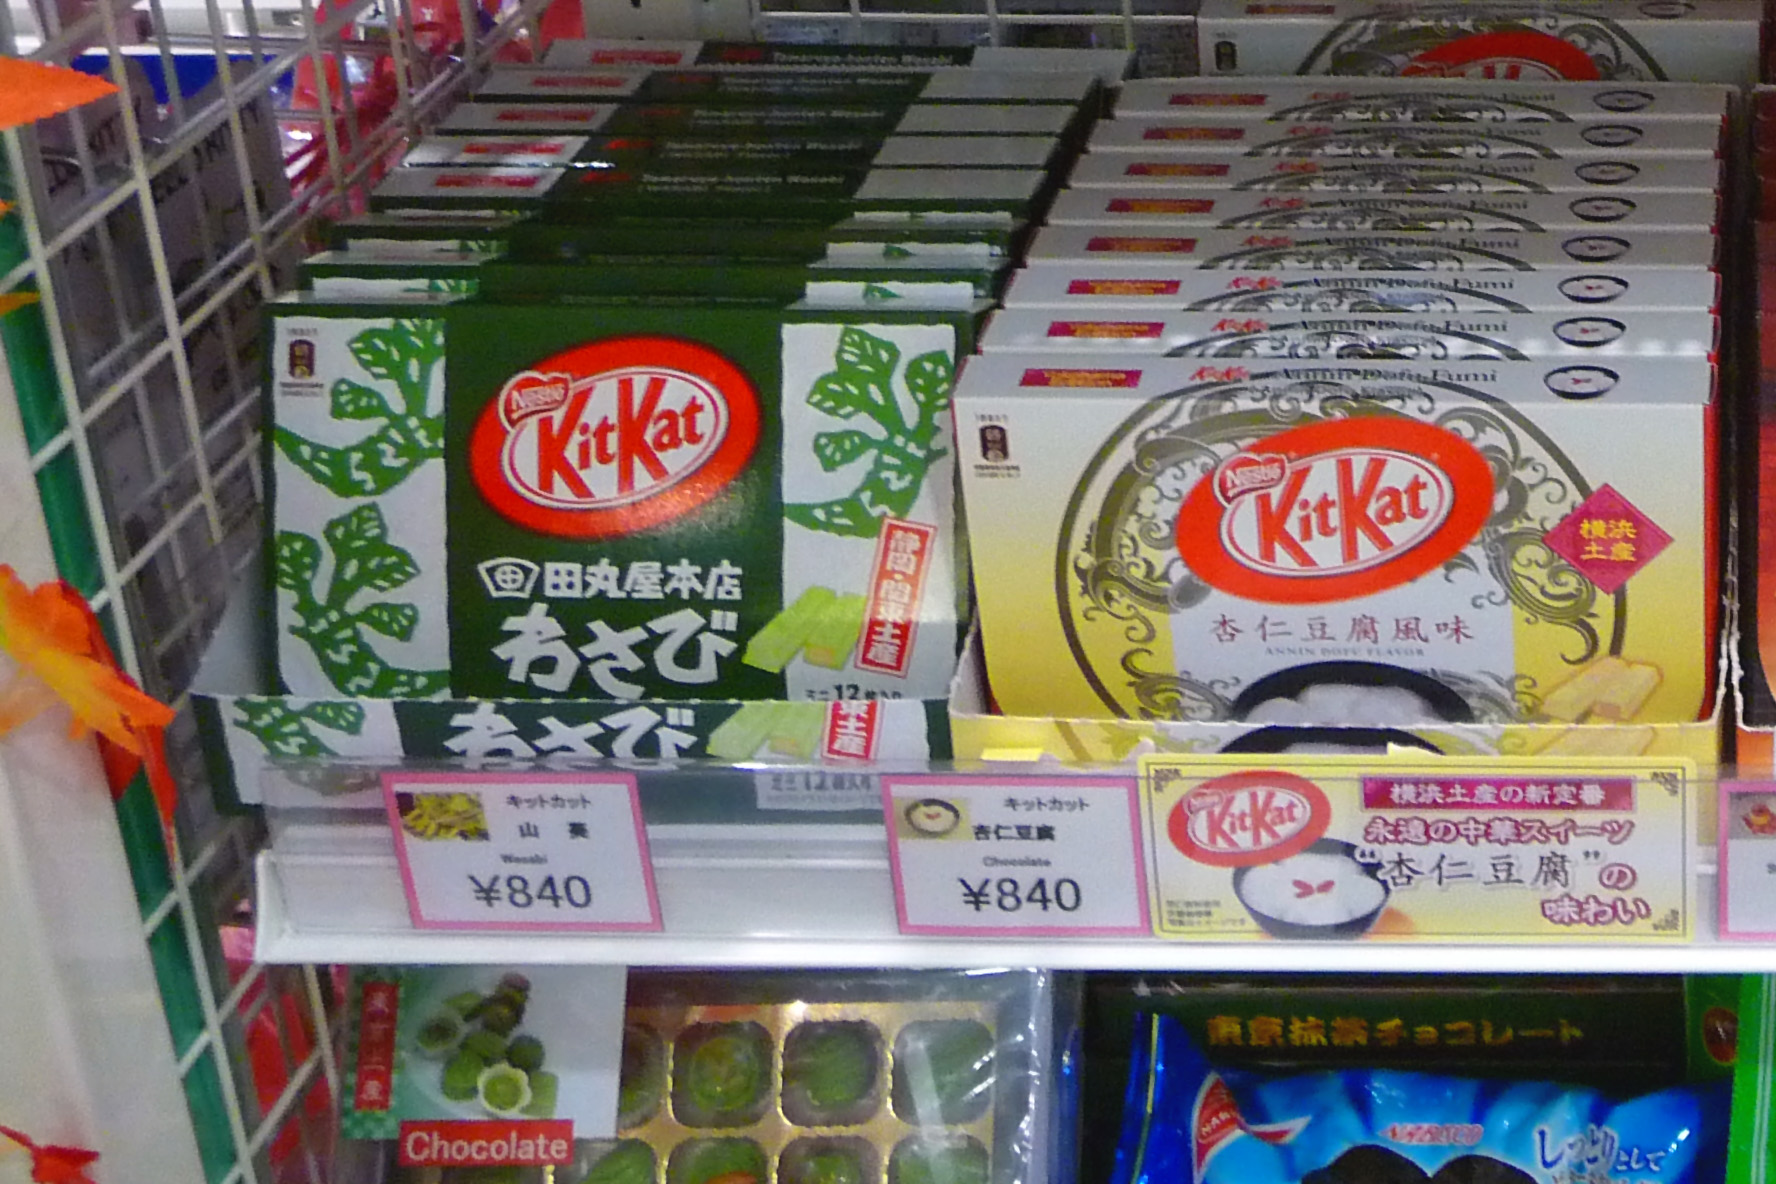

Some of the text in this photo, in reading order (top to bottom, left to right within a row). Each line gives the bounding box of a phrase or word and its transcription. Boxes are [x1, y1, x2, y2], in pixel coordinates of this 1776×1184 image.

[538, 376, 706, 500] KitKat
[1255, 456, 1430, 567] KitKat
[1578, 518, 1638, 540] 横浜
[1578, 540, 1638, 563] 土産
[543, 557, 743, 601] 田丸屋本店
[1210, 613, 1476, 645] 杏仁豆腐風味
[490, 601, 740, 701] わさび
[506, 794, 592, 809] キットカット
[1003, 797, 1090, 812] キットカット
[972, 824, 1056, 841] 杏仁豆腐
[1205, 790, 1299, 851] KitKat
[467, 874, 593, 909] ¥840
[957, 877, 1083, 912] ¥840
[1540, 896, 1652, 926] 味わい
[405, 1130, 570, 1164] Chocolate
